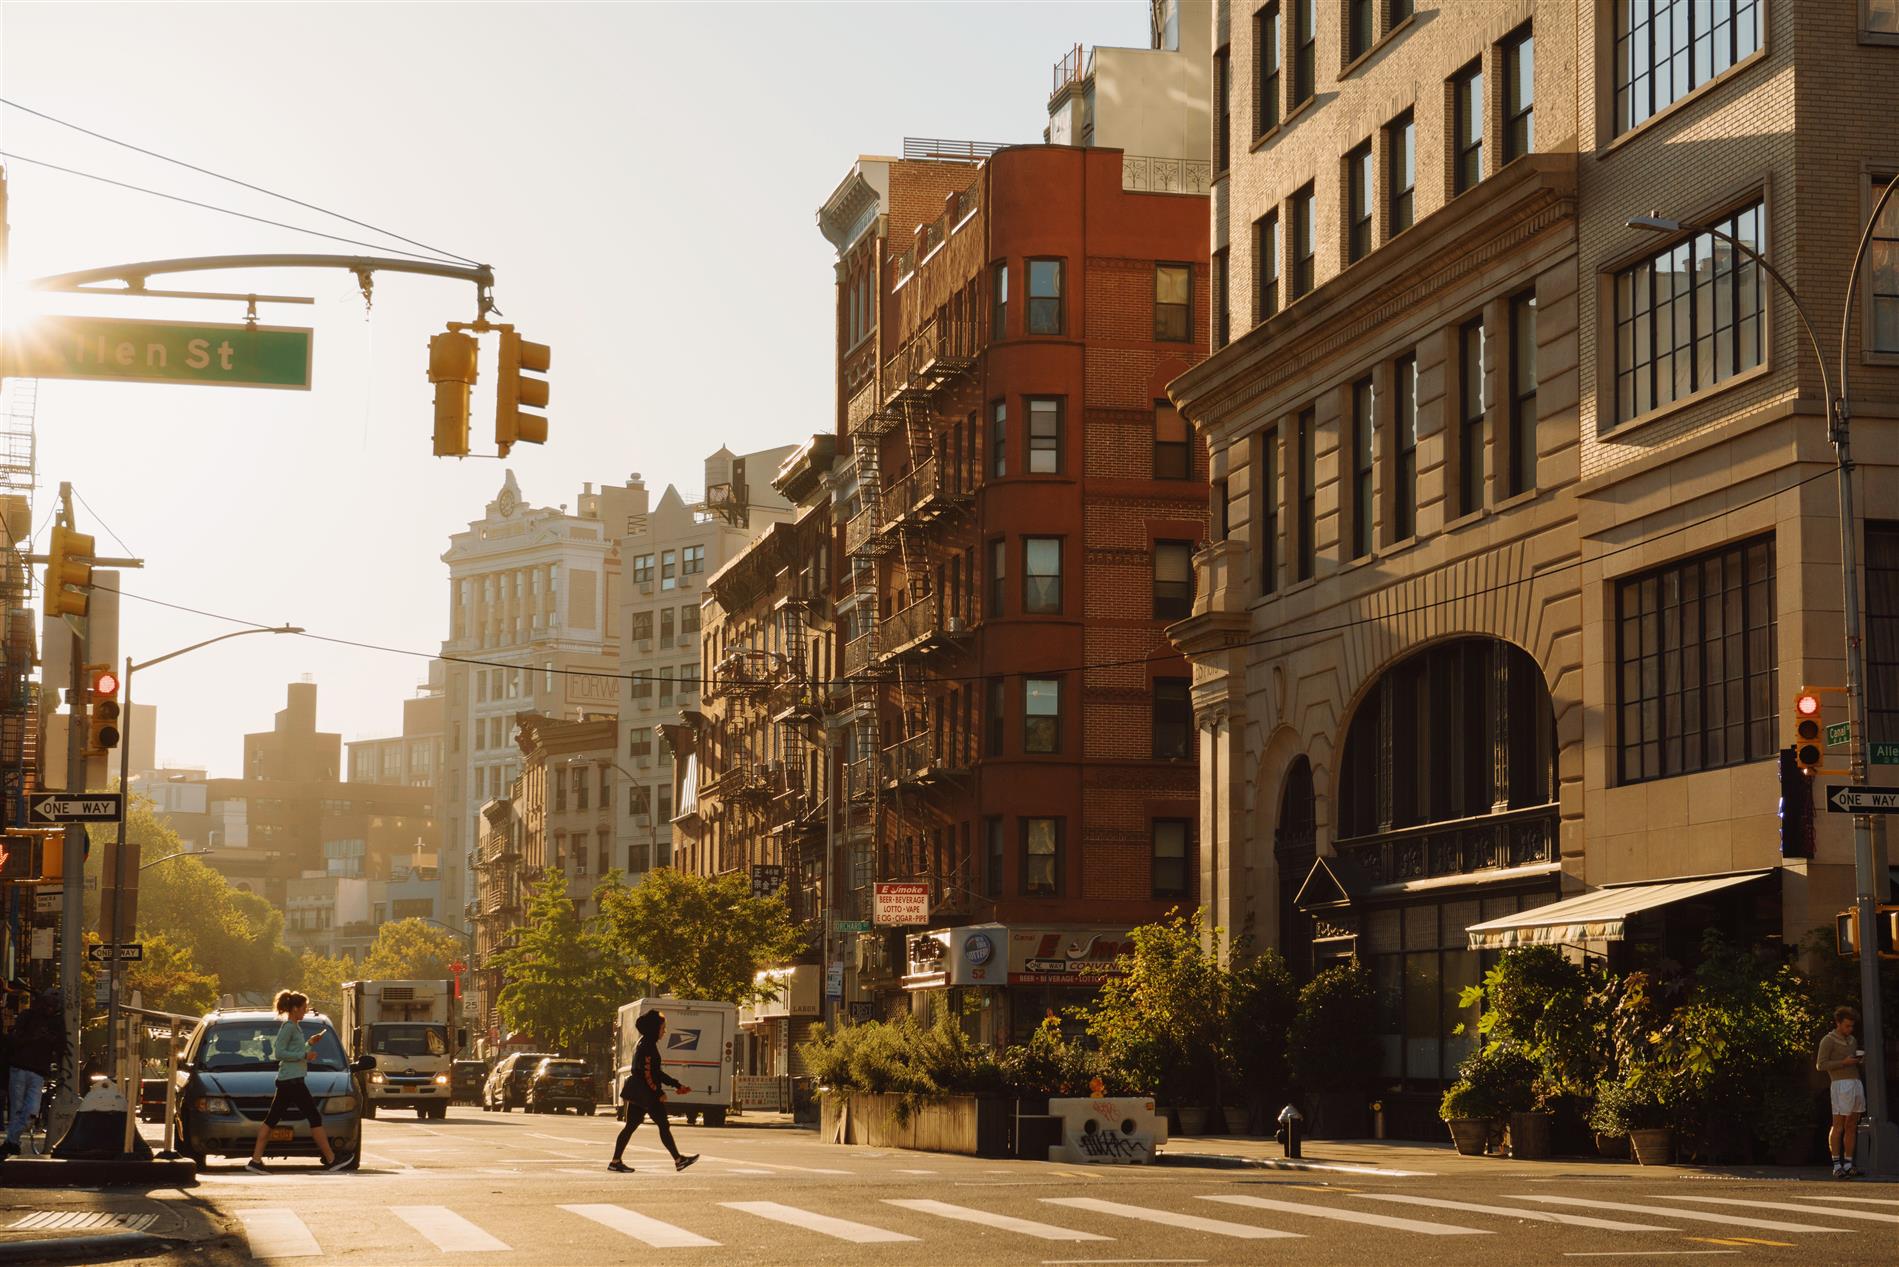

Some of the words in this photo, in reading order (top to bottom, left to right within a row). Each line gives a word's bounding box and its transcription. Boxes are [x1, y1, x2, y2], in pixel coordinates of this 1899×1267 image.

[75, 335, 167, 367] llen
[185, 338, 234, 370] St
[1829, 725, 1846, 739] Canal
[1839, 794, 1861, 805] ONE
[1872, 794, 1896, 806] WAY
[43, 803, 69, 814] ONE
[82, 802, 110, 814] WAY
[881, 885, 889, 894] E
[879, 896, 893, 904] BEER
[895, 896, 925, 904] BEVERAGE
[883, 905, 902, 913] LOTTO
[905, 905, 920, 913] VAPE
[881, 914, 892, 922] CIG
[894, 914, 913, 922] CIGAR
[915, 914, 927, 923] PIPE
[1036, 934, 1061, 958] E
[971, 968, 986, 979] 52
[1019, 975, 1035, 983] BEER
[465, 1001, 478, 1010] 25
